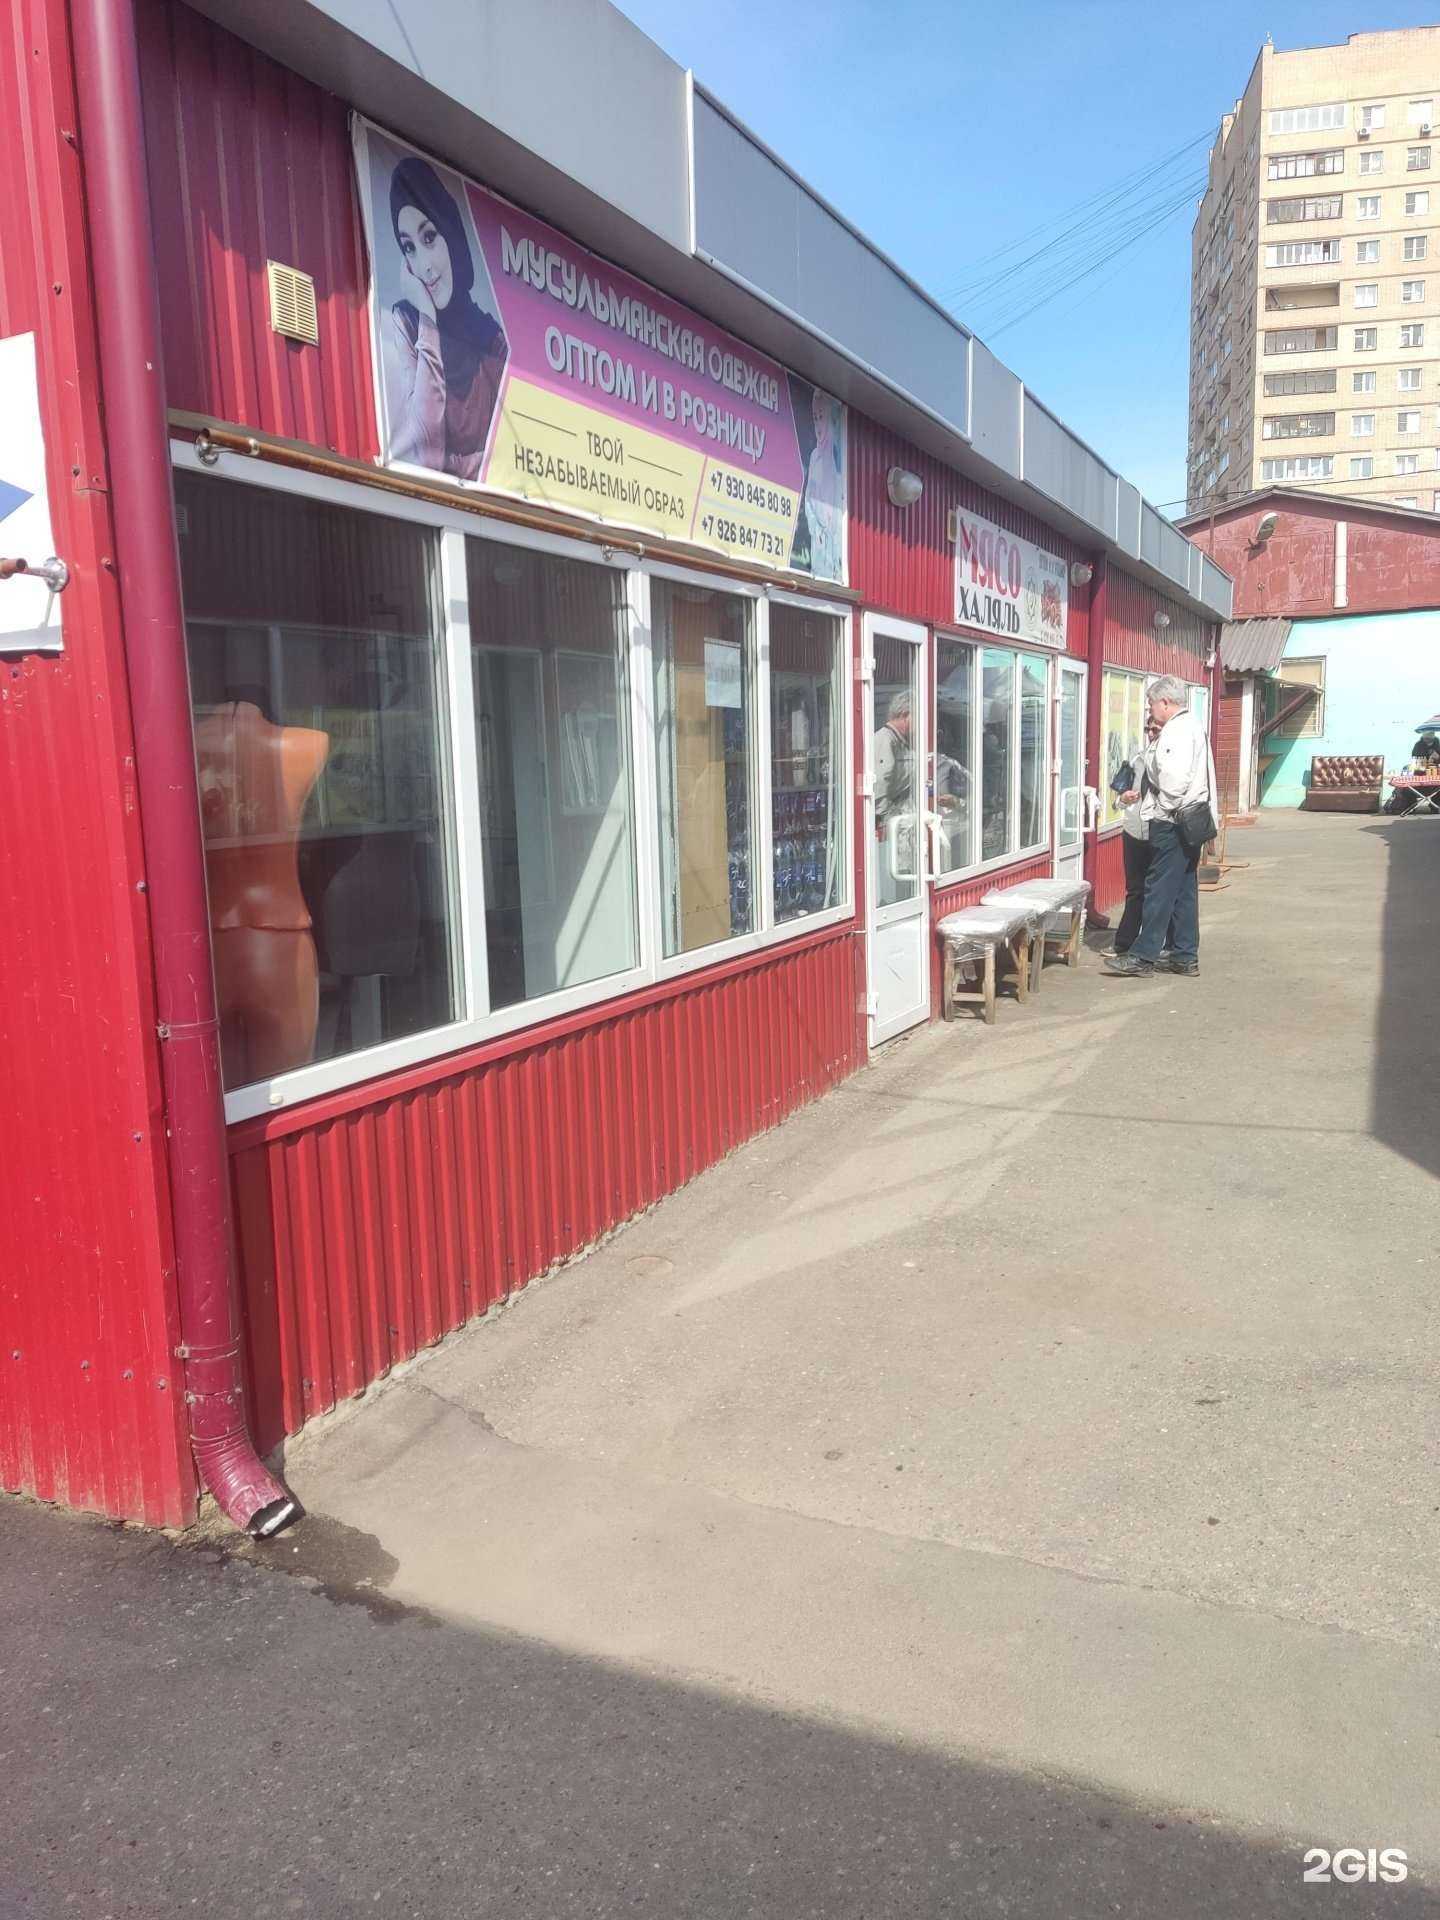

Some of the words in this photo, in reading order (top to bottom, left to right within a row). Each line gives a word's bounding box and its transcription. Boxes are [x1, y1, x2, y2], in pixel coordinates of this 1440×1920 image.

[501, 224, 705, 375] МУСУЛЬМАНСКАЯ
[708, 345, 779, 414] ОДЕЖДА
[545, 326, 637, 408] ОПТОМ
[641, 370, 659, 414] И
[663, 381, 677, 421] В
[681, 390, 766, 464] РОЗНИЦУ
[586, 431, 625, 466] ТВОЙ
[514, 444, 641, 507] НЕЗАБЫВАЕМЫЙ
[644, 487, 686, 520] ОБРАЗ
[711, 470, 723, 493] +7
[726, 475, 745, 501] 930
[747, 483, 766, 508] 845
[768, 491, 779, 513] 80
[780, 496, 792, 517] 98
[702, 515, 714, 537] +7
[740, 526, 758, 549] 847
[761, 532, 773, 554] 73
[774, 536, 784, 557] 21
[959, 516, 1022, 600] МЯСО
[958, 585, 1021, 634] ХАЛЯЛЬ
